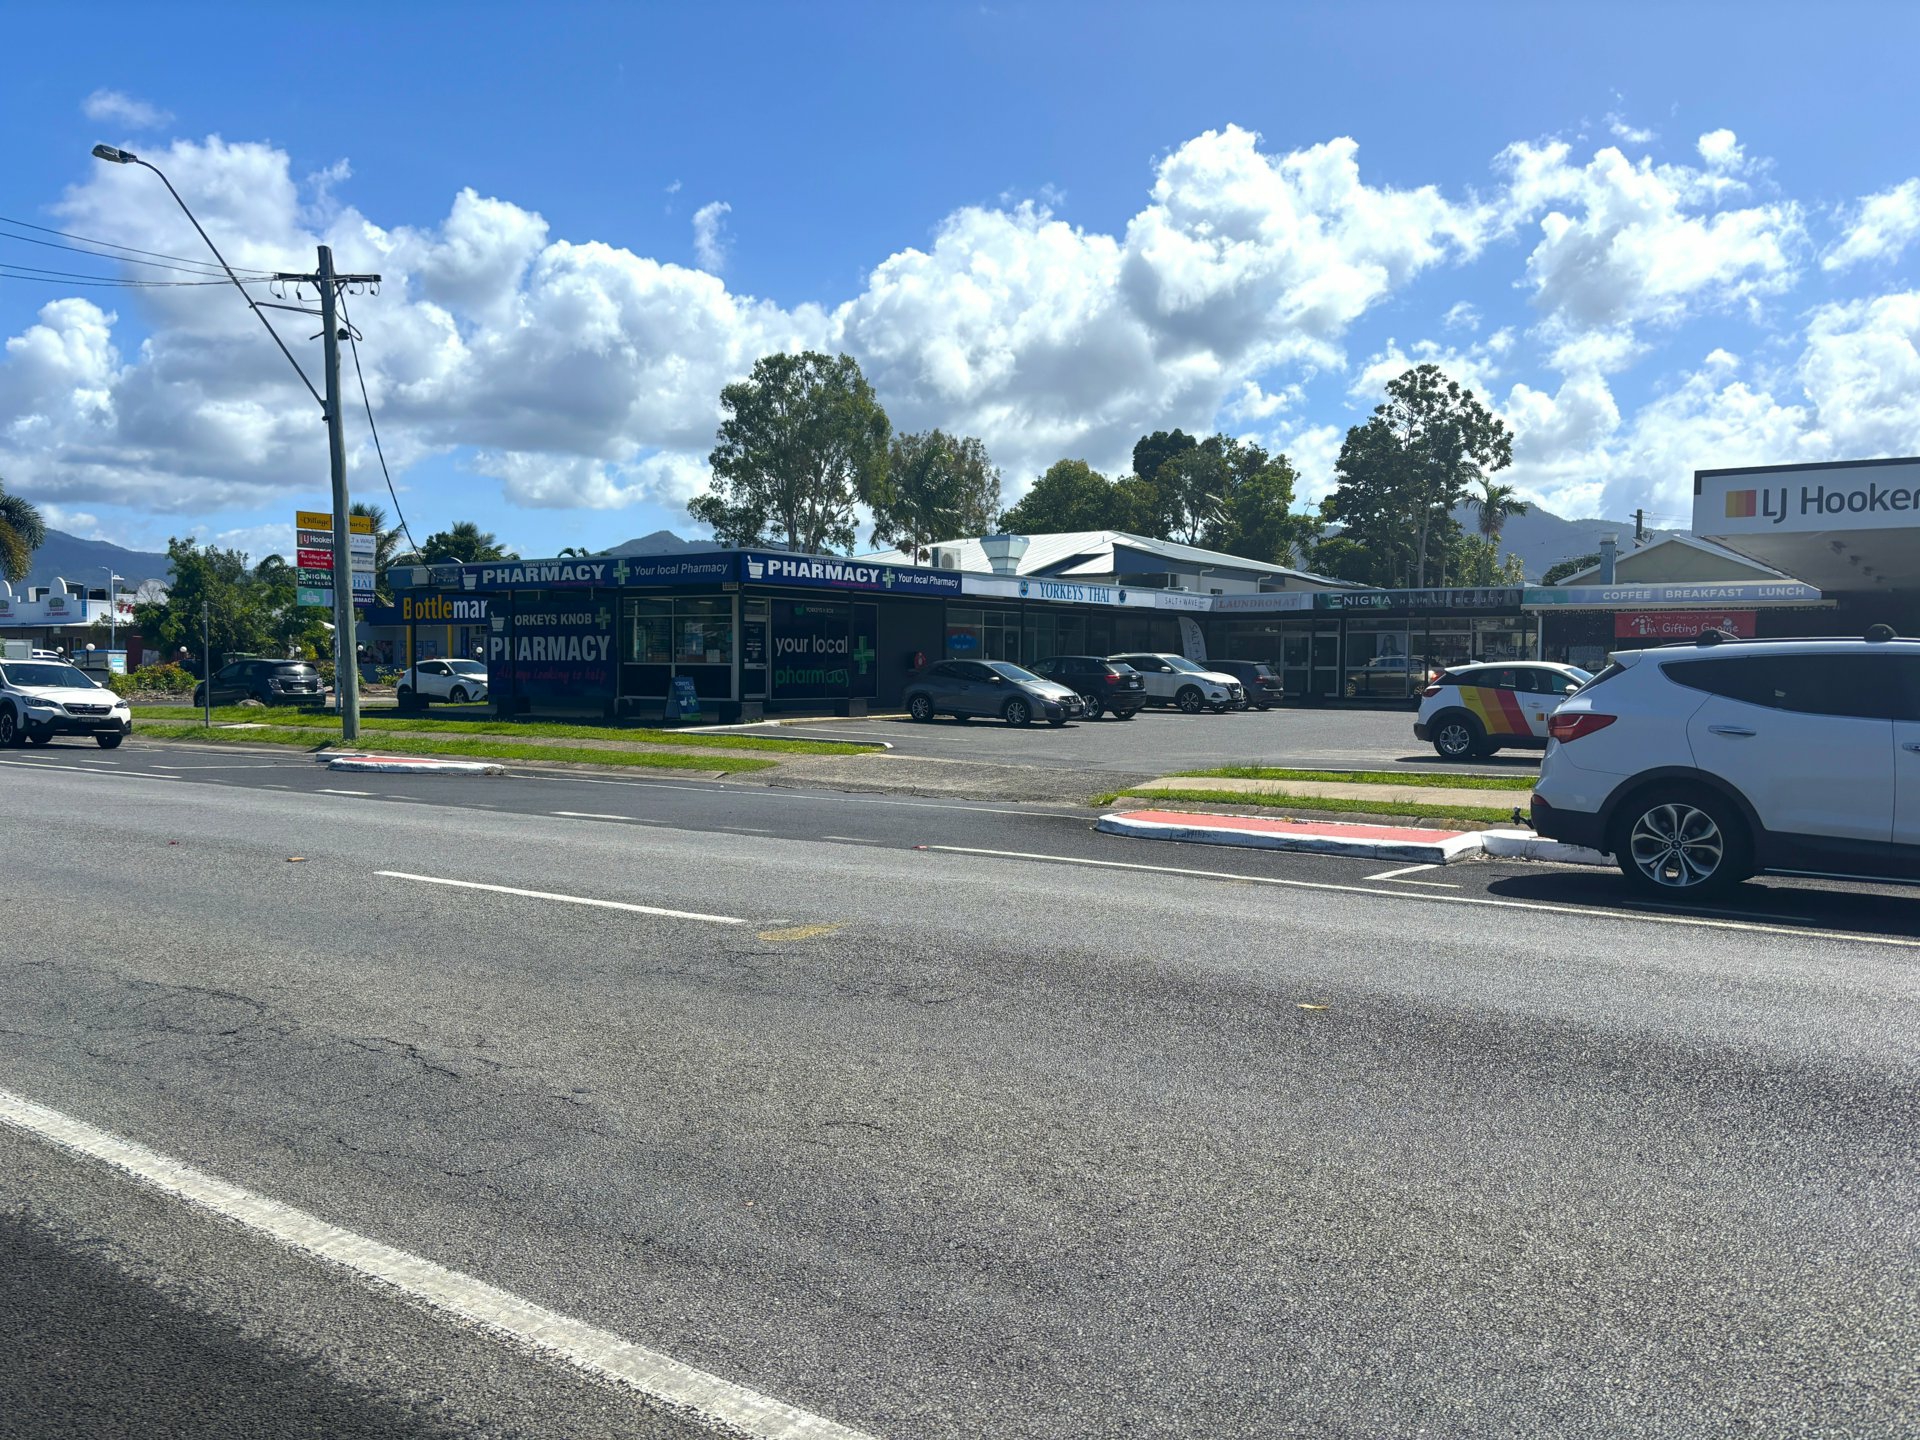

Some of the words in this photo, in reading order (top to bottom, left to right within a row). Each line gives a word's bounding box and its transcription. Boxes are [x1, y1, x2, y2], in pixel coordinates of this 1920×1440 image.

[1763, 488, 1787, 524] LJ
[1801, 483, 1920, 515] Hooker
[303, 535, 309, 545] LJ
[482, 564, 605, 584] PHARMACY
[635, 566, 655, 576] Your
[657, 564, 679, 575] local
[681, 563, 728, 575] Pharmacy
[767, 559, 880, 583] PHARMACY
[352, 579, 372, 588] HAI
[898, 573, 913, 584] Your
[914, 574, 929, 584] local
[929, 575, 959, 589] Pharmacy
[1040, 582, 1084, 601] YORKEYS
[1088, 586, 1110, 603] THAI
[1602, 590, 1651, 600] COFFEE
[1665, 588, 1744, 599] BREAKFAST
[1758, 587, 1805, 596] LUNCH
[1165, 597, 1178, 605] SALT
[1330, 594, 1392, 608] ENIGMA
[508, 613, 557, 626] ORKEYS
[560, 612, 592, 625] KNOB
[1662, 622, 1697, 635] Gifting
[490, 635, 611, 662] PHARMACY
[775, 637, 808, 656] your
[813, 634, 848, 654] local
[775, 665, 849, 688] pharmacy
